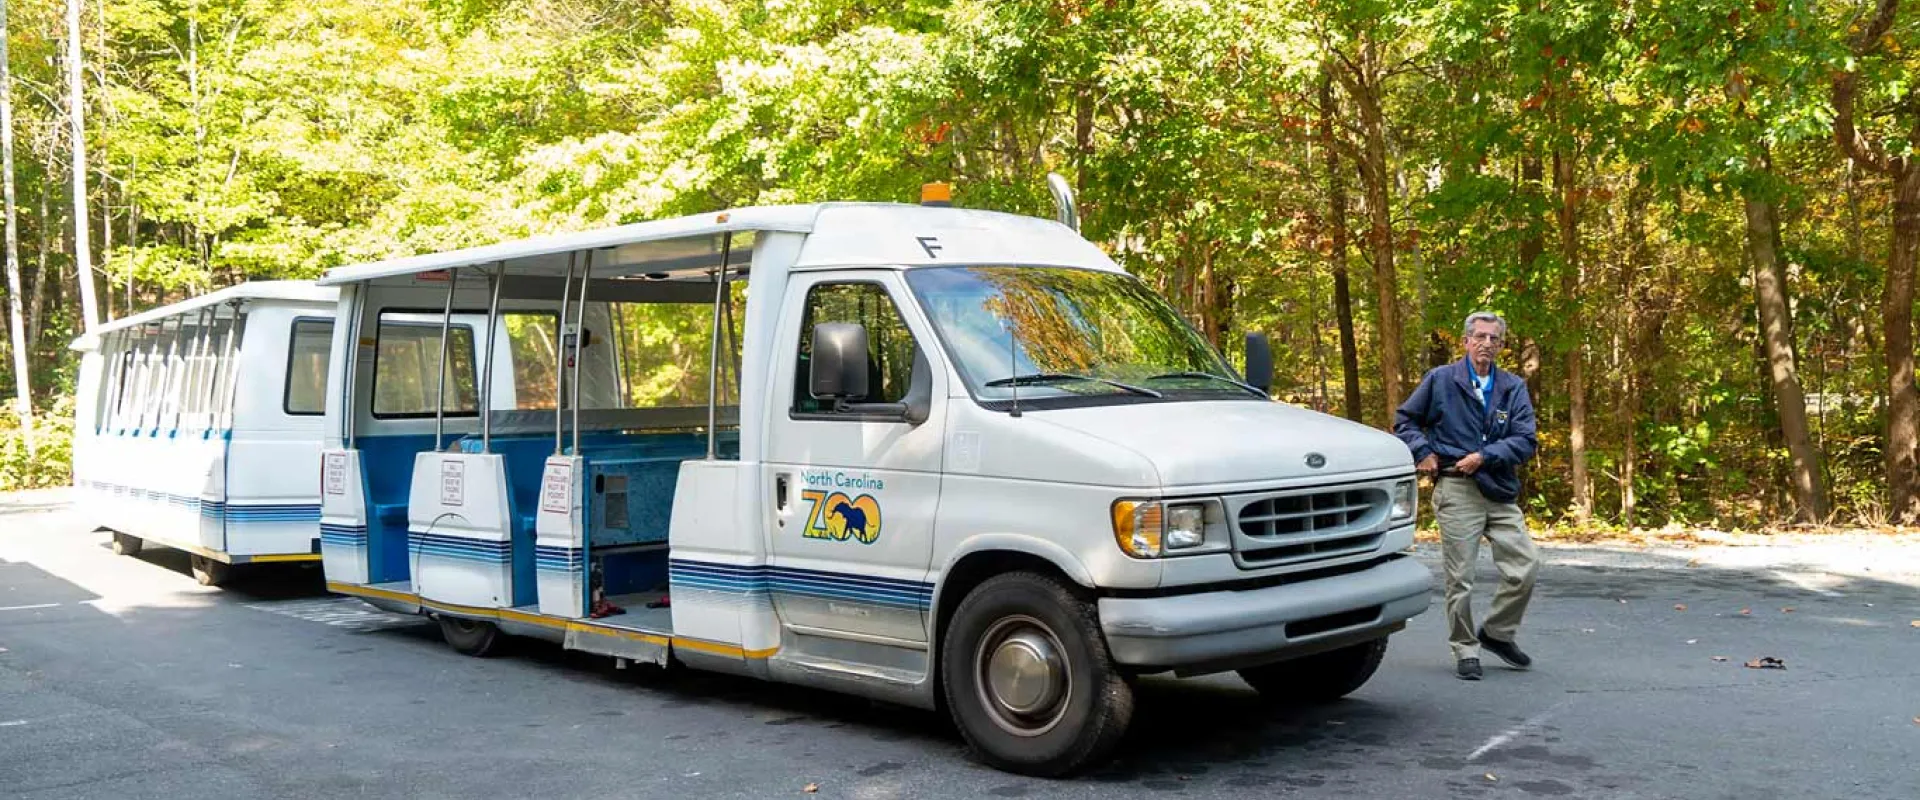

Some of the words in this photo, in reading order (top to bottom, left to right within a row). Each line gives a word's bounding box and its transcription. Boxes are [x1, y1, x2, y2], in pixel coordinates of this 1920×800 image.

[916, 236, 943, 259] F
[801, 471, 833, 486] North
[835, 472, 884, 489] Carolina
[801, 489, 882, 544] ZOO
